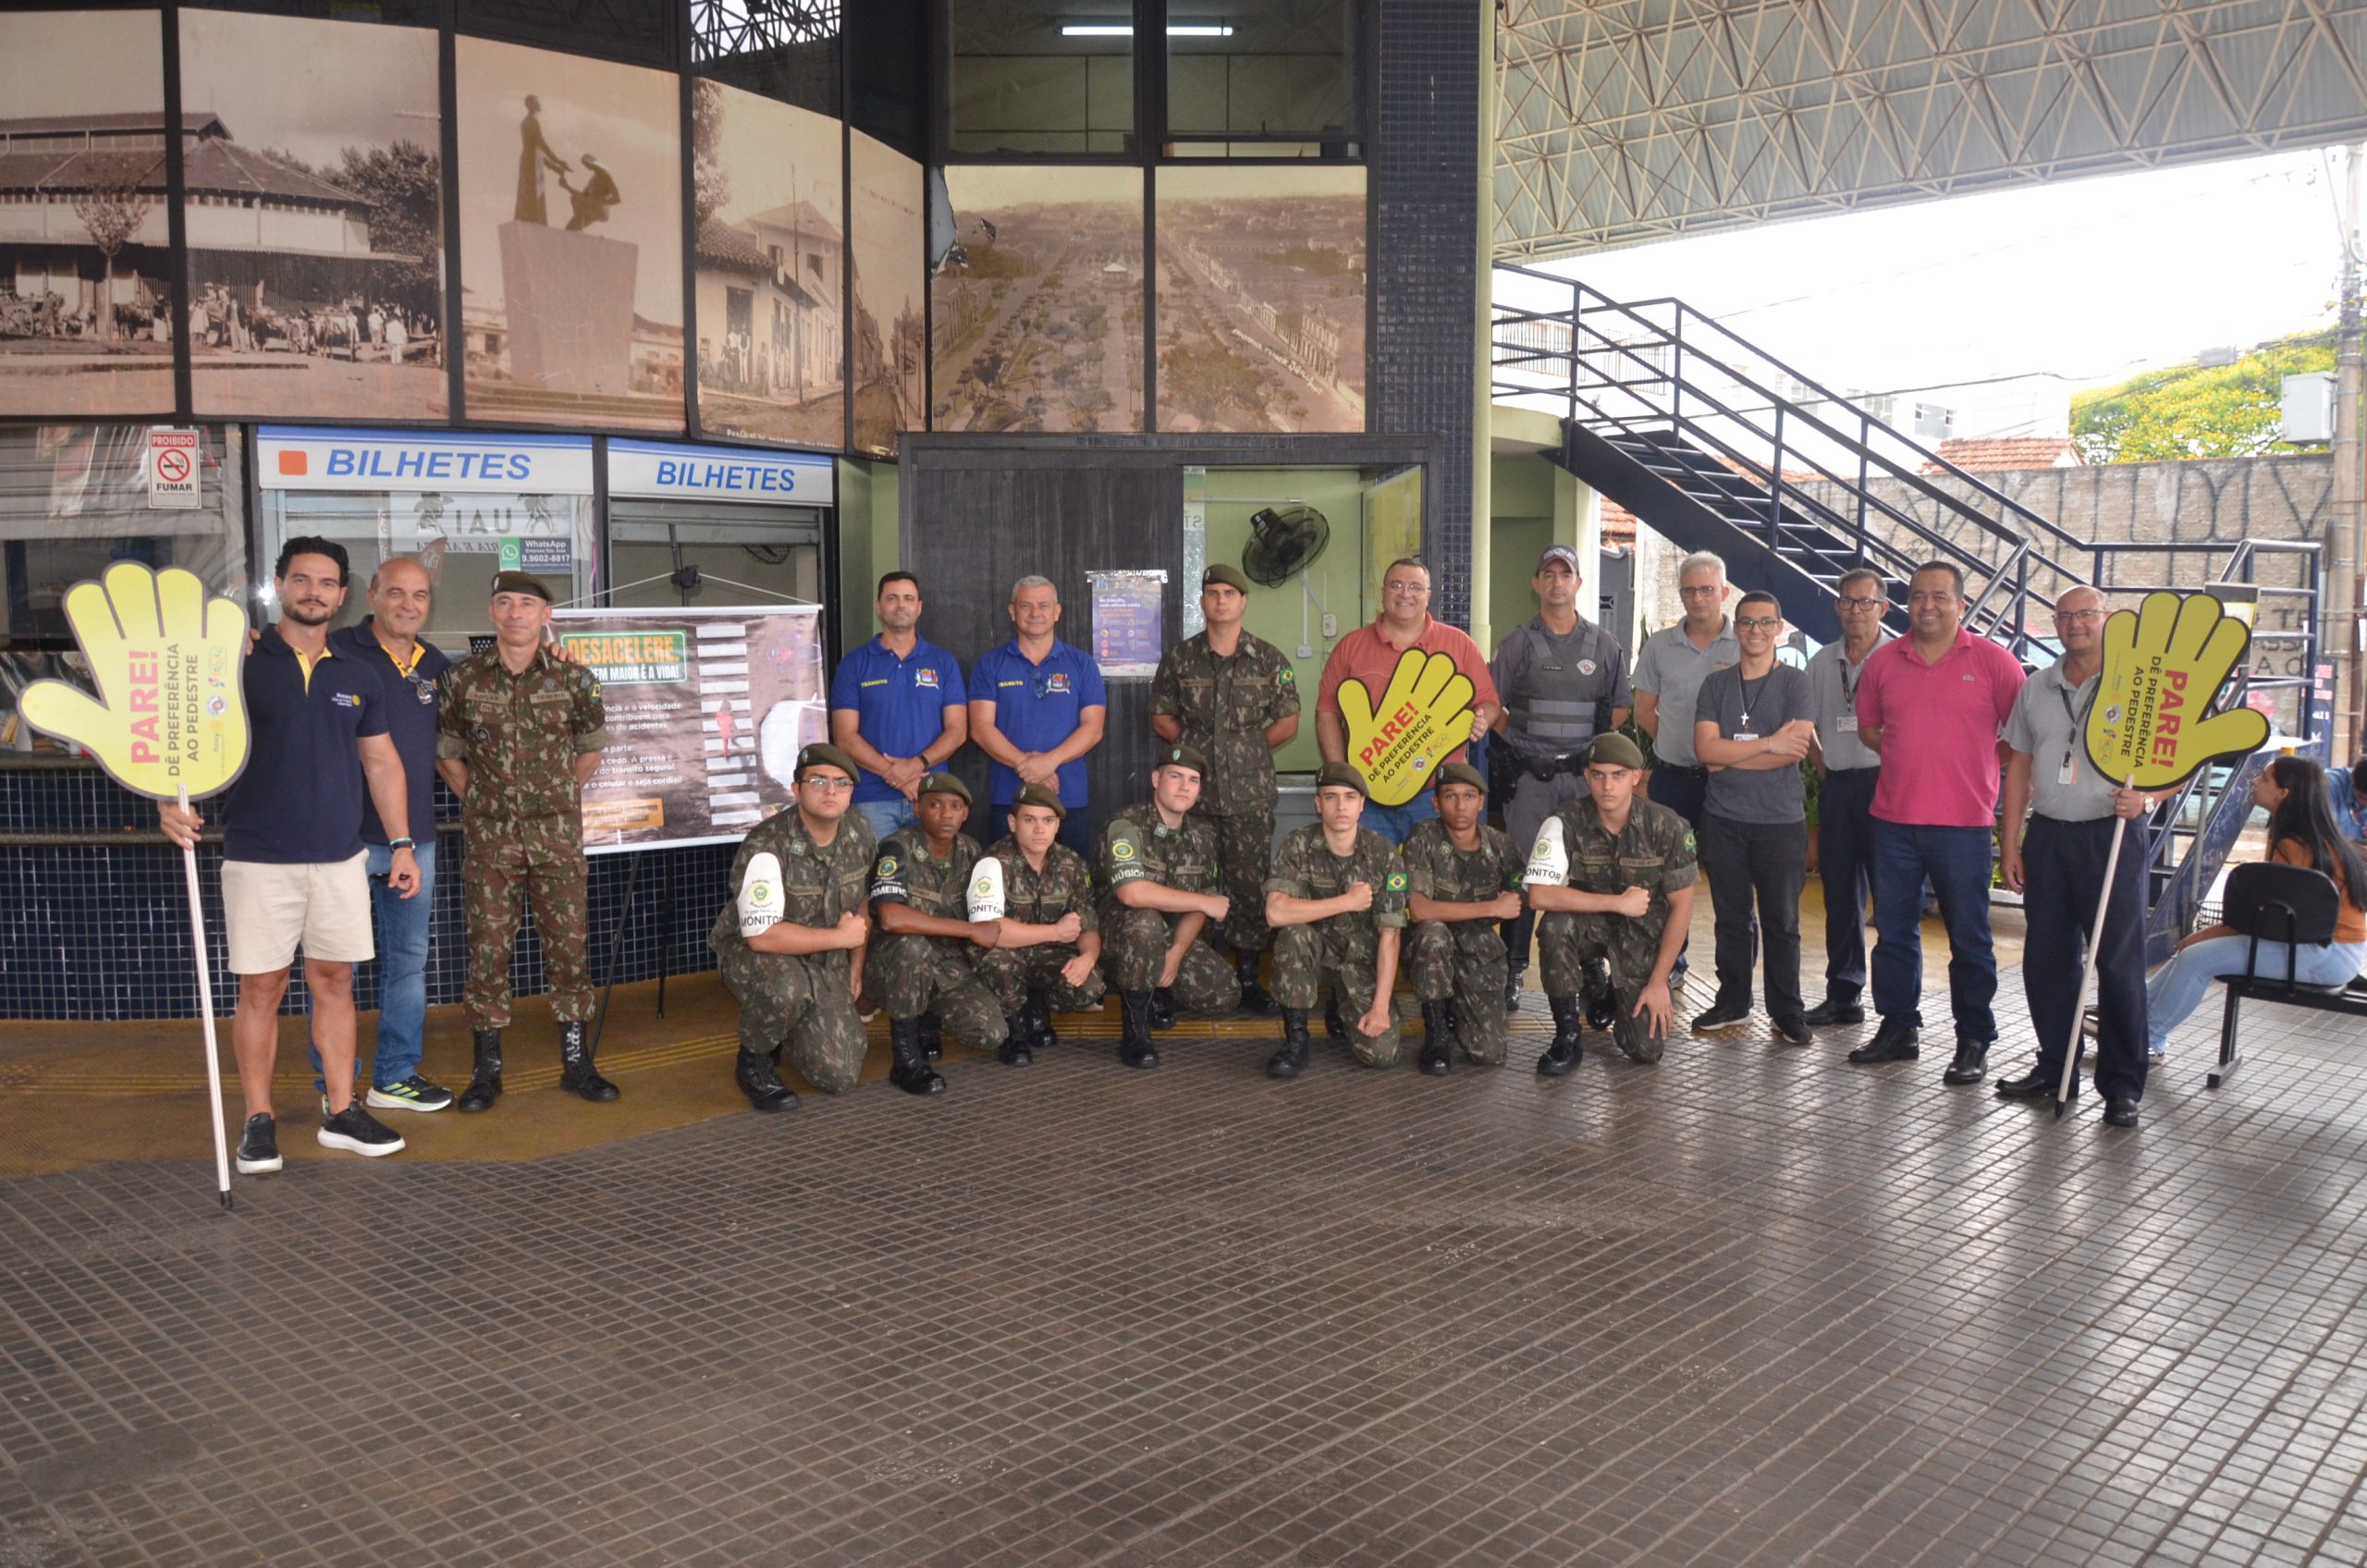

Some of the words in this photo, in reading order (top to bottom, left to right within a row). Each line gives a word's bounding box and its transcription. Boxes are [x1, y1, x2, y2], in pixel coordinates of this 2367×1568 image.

[152, 436, 194, 446] PROIBIDO
[326, 449, 532, 480] BILHETES
[656, 460, 796, 492] BILHETES
[525, 540, 567, 548] WhatsApp
[567, 636, 681, 666] DESACELERE.
[610, 667, 639, 680] MAIOR
[641, 664, 646, 680] É
[649, 667, 655, 679] A
[656, 666, 680, 679] VIDA!
[2150, 655, 2162, 674] DÊ
[2132, 667, 2144, 686] AO
[165, 643, 180, 751] PREFERÊNCIA
[186, 655, 199, 734] PEDESTRE
[129, 651, 160, 763] PARE!
[605, 714, 652, 722] contribuem
[639, 703, 681, 711] velocidade
[2151, 669, 2189, 768] PARE!
[629, 722, 668, 730] acidentes
[1359, 701, 1419, 767] PARE!
[2121, 690, 2140, 756] PEDESTRE
[2133, 678, 2158, 768] PREFERÊNCIA
[187, 739, 199, 762] AO
[1367, 768, 1381, 782] DÊ
[1380, 714, 1432, 769] PREFERÊNCIA
[1382, 768, 1395, 783] AO
[1394, 727, 1435, 769] PEDESTRE
[165, 754, 180, 776] DÊ
[612, 765, 644, 774] trânsito
[645, 764, 675, 772] seguro!
[599, 779, 626, 788] celular
[635, 778, 651, 786] seja
[653, 777, 682, 785] cordial!
[1526, 868, 1561, 882] ONITOR
